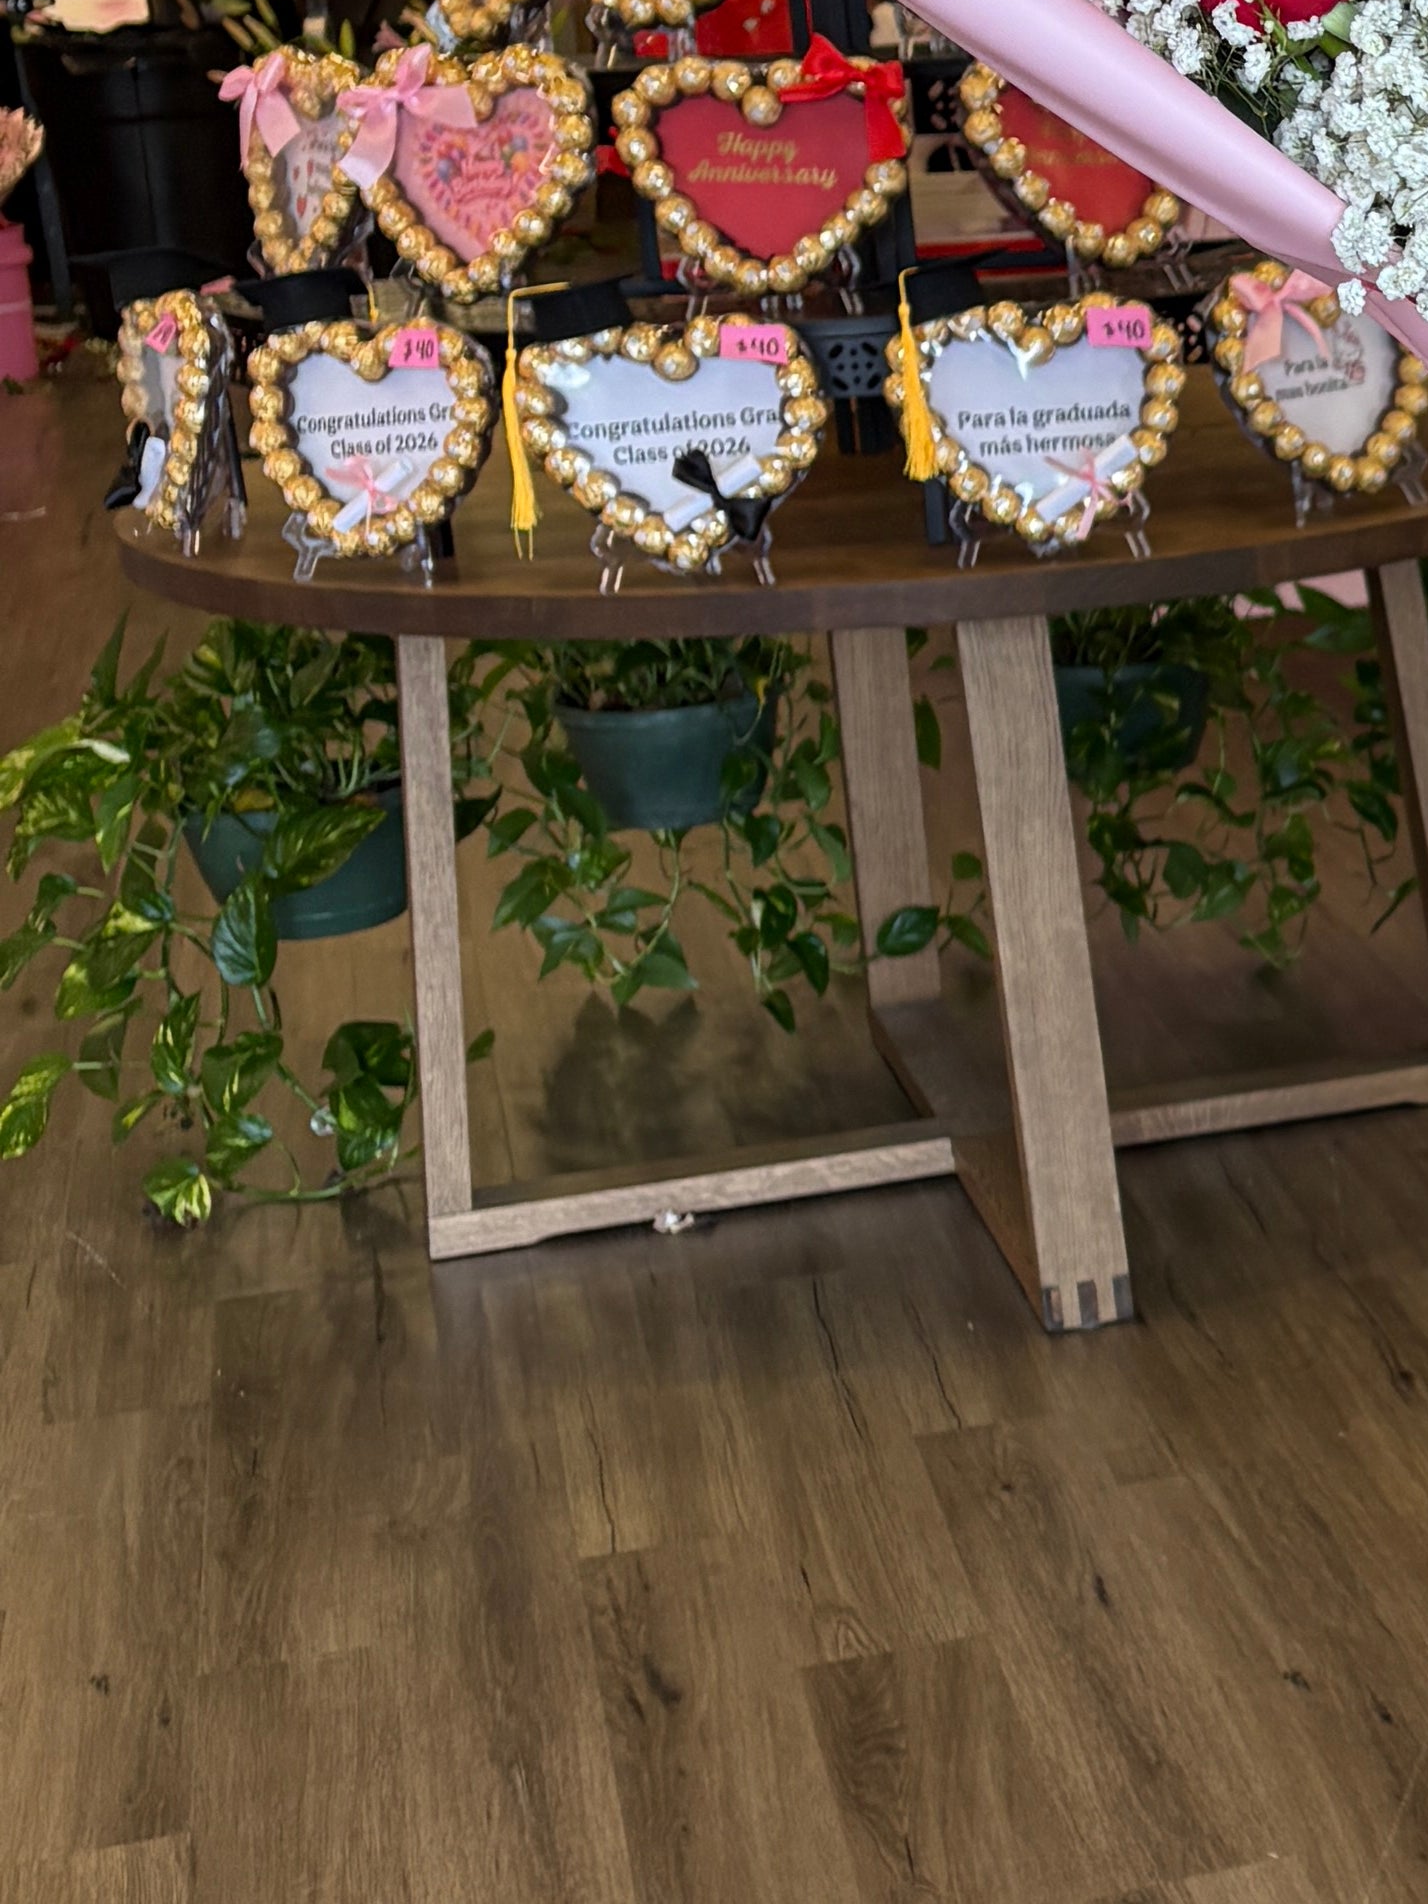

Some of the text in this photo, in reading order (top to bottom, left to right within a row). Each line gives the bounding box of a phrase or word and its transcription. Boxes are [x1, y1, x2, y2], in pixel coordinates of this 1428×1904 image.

[717, 132, 798, 164] Happy
[687, 159, 838, 190] Anniversary
[1102, 319, 1145, 340] $40
[403, 338, 434, 362] $40
[736, 337, 779, 357] $40
[296, 406, 426, 435] Congratulations
[567, 410, 736, 442] Congratulations
[958, 399, 1131, 430] Para la graduada
[331, 432, 438, 459] Class of 2026
[613, 444, 668, 466] Class
[1026, 430, 1117, 454] hermosa
